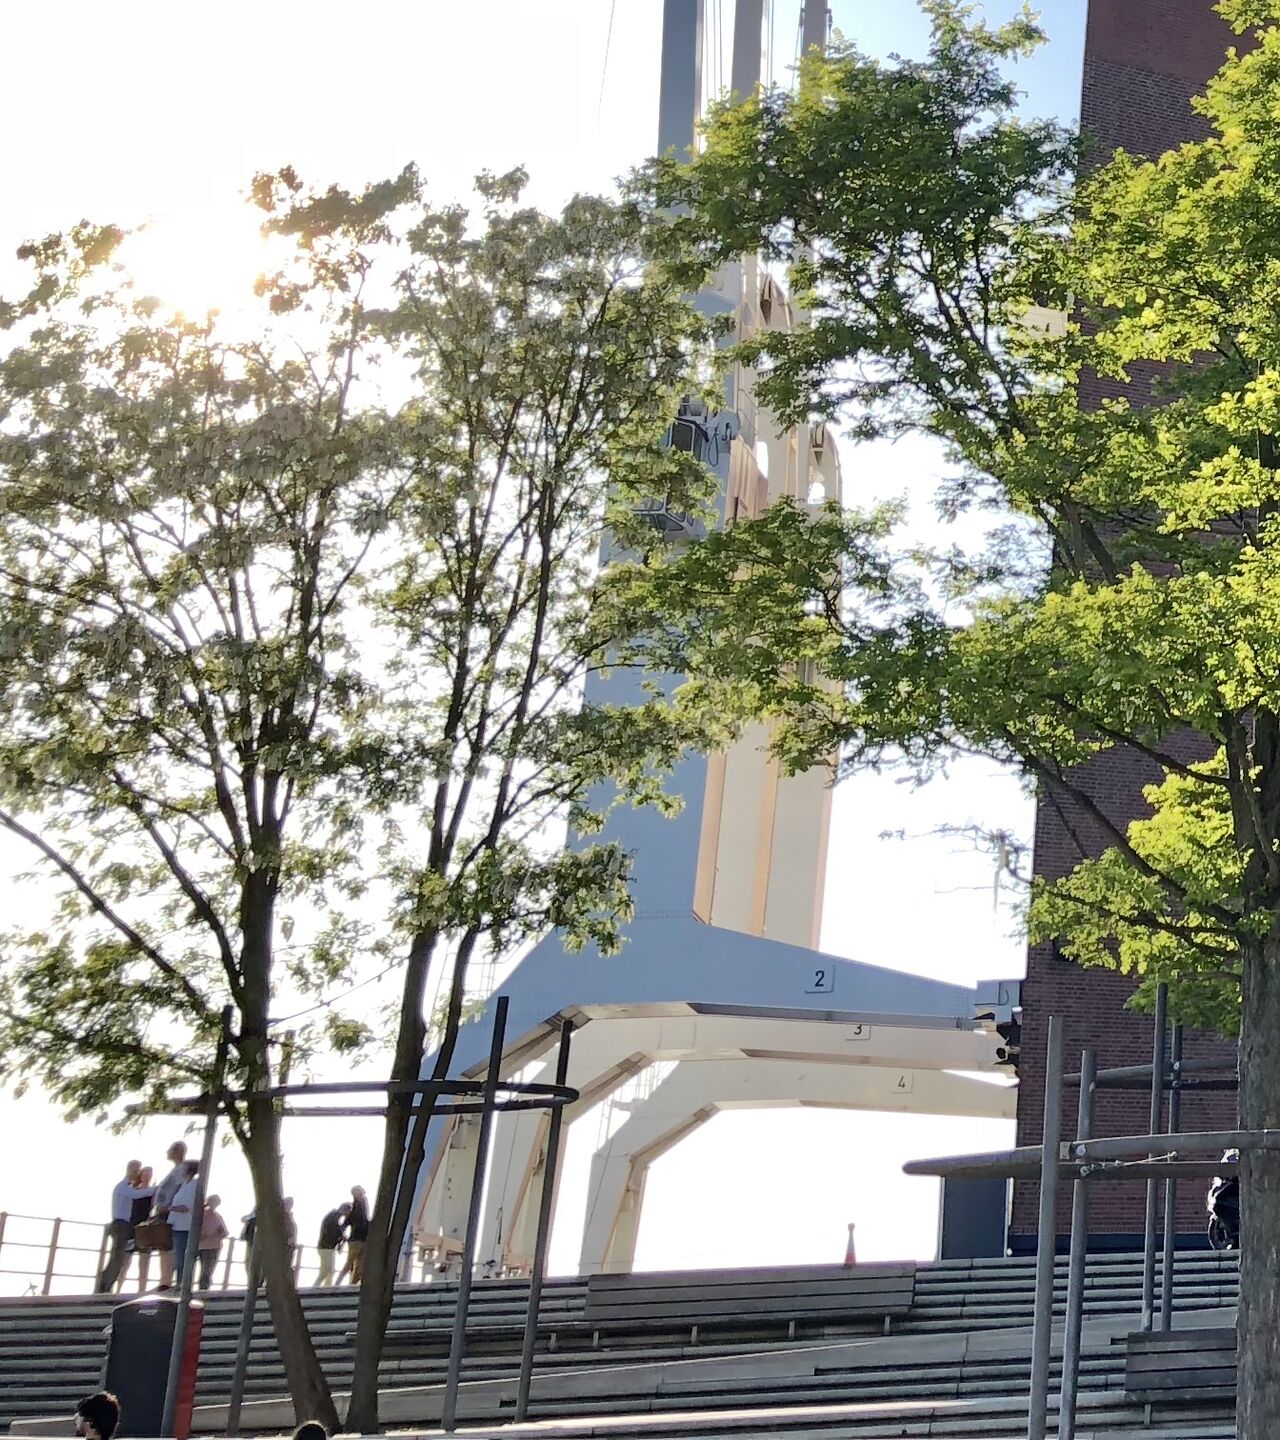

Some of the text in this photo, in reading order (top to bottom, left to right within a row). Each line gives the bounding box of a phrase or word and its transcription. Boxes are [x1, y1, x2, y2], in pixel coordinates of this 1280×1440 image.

[815, 970, 825, 988] 2
[853, 1024, 863, 1035] 3
[897, 1076, 906, 1089] 4
